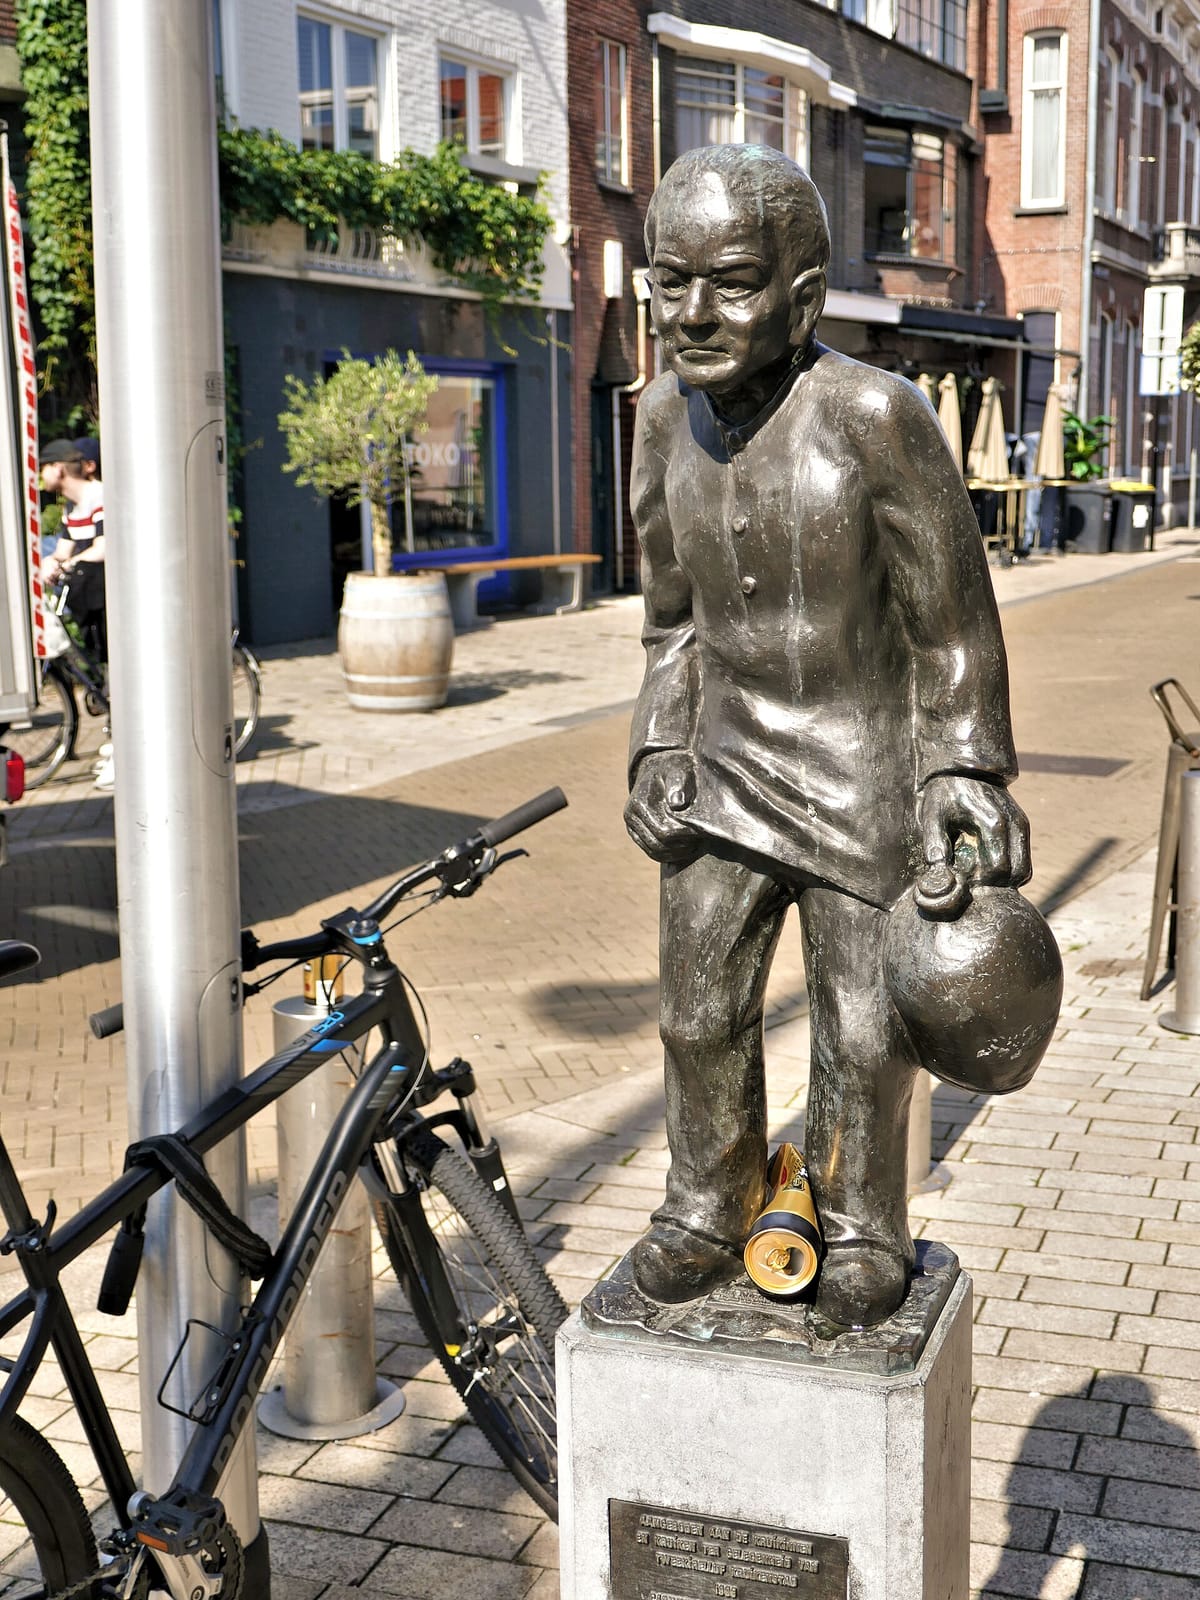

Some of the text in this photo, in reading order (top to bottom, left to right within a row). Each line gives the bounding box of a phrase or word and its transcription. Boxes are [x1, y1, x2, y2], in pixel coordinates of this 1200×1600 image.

[405, 443, 460, 466] TOKO
[311, 1011, 345, 1034] 520
[212, 1170, 347, 1480] ROCKRIDER
[709, 1525, 732, 1541] AAN
[735, 1529, 749, 1544] DE
[636, 1530, 650, 1545] EN
[702, 1541, 721, 1557] TER
[798, 1556, 820, 1575] VAN
